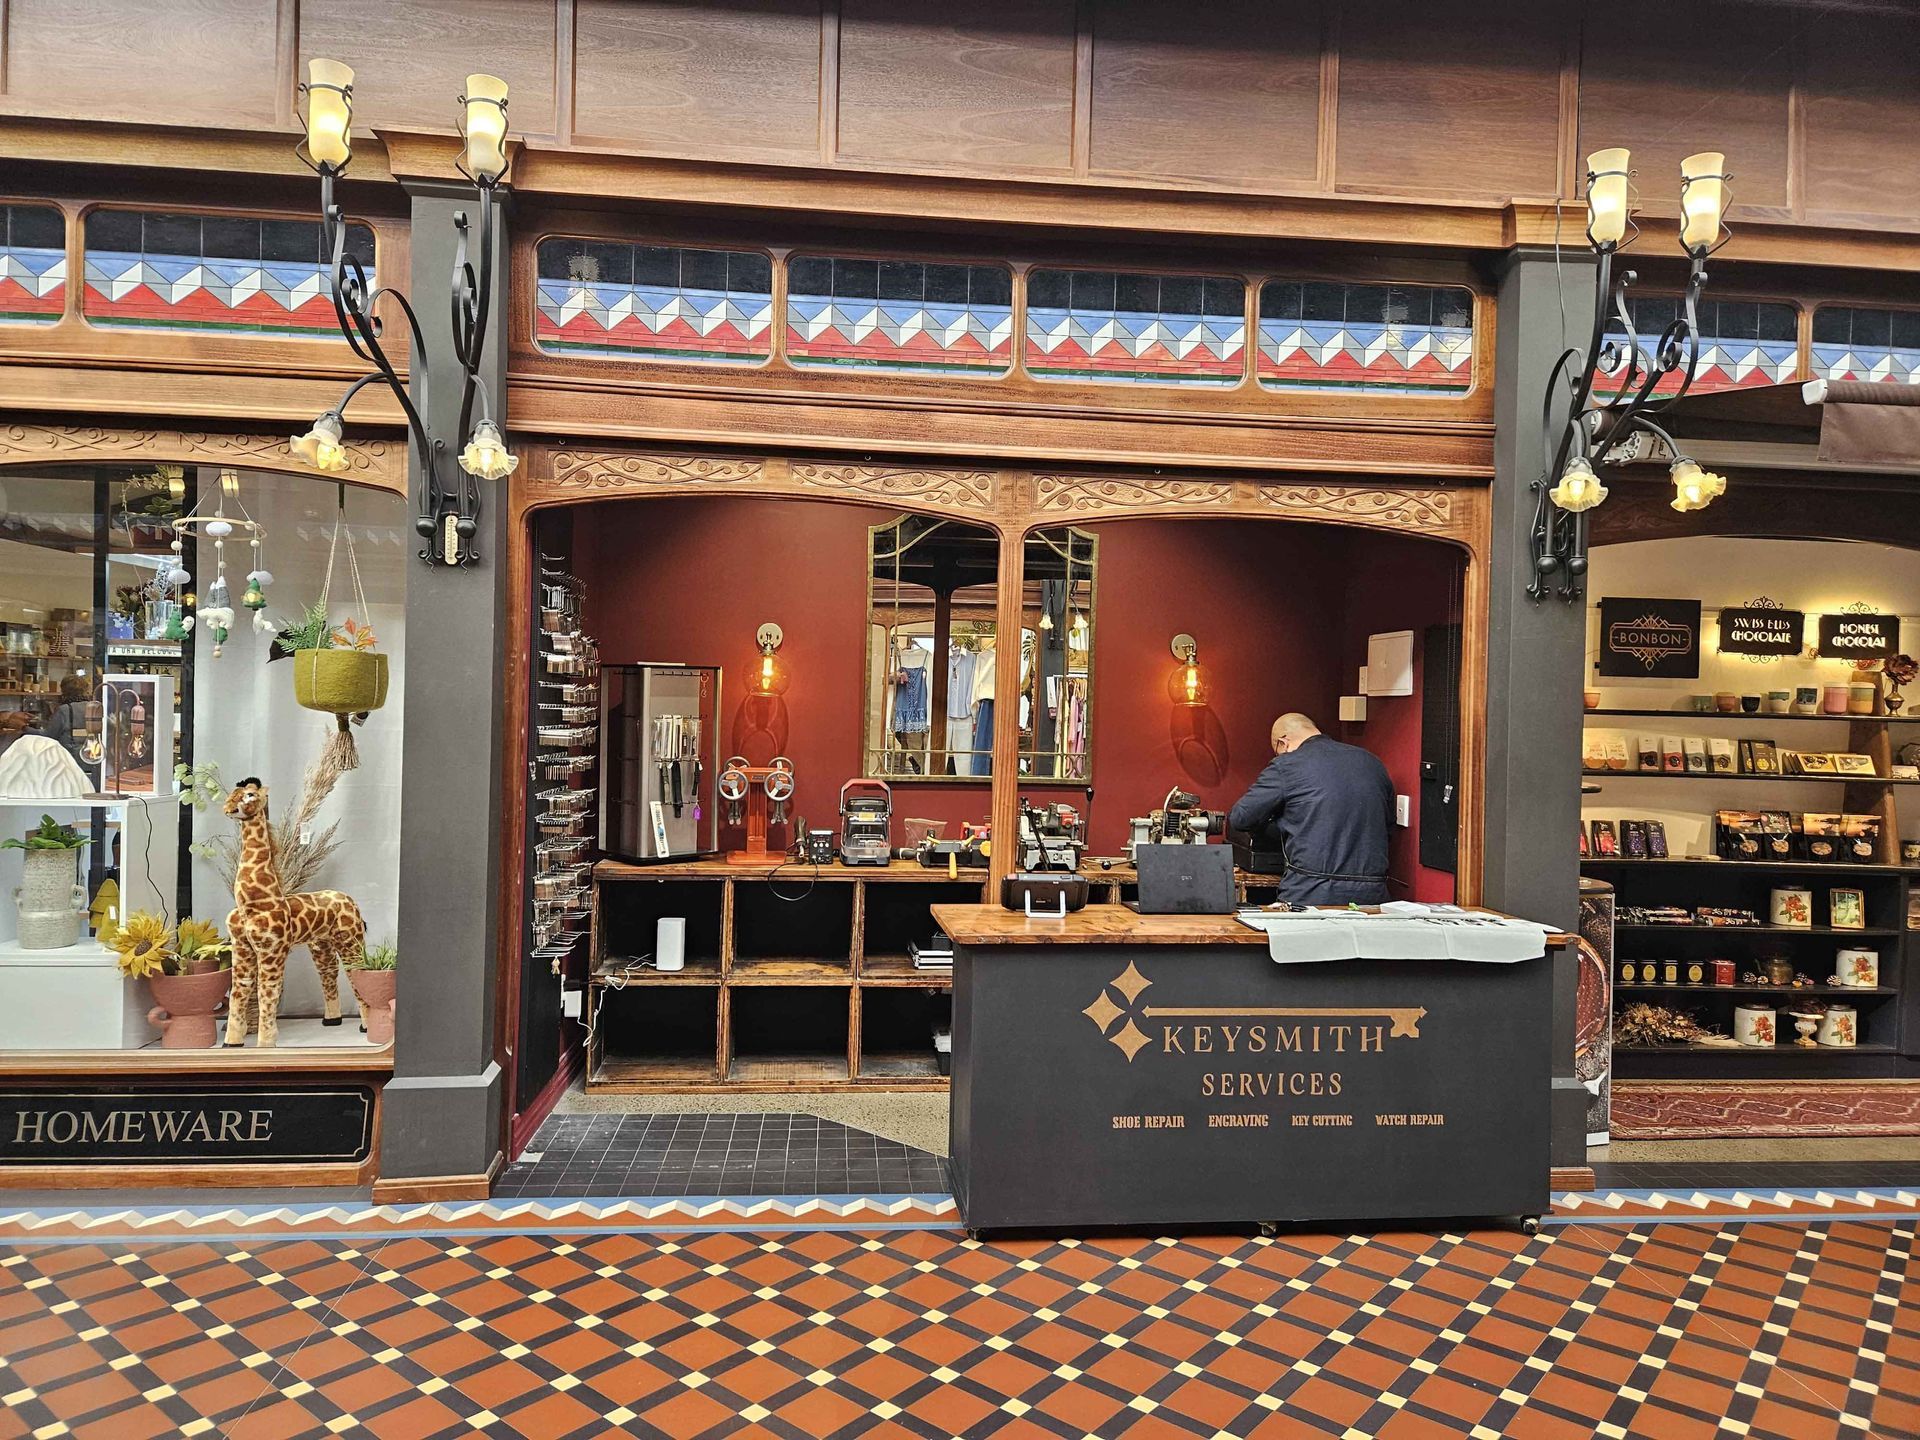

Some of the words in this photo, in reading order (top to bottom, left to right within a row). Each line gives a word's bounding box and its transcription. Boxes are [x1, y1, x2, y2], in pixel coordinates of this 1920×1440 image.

[1734, 618, 1764, 629] SWISS
[1767, 619, 1791, 630] BLISS
[1839, 623, 1880, 635] HONEST
[1620, 632, 1681, 645] BONBON
[1731, 630, 1792, 643] CHOCOLATE
[1163, 1025, 1384, 1054] KEYSMITH
[1202, 1072, 1342, 1097] SERVICES
[11, 1109, 274, 1144] HOMEWARE
[1112, 1115, 1141, 1129] SHOE
[1144, 1115, 1185, 1128] REPAIR
[1208, 1114, 1269, 1127] ENGRAVING
[1291, 1115, 1310, 1126] KEY
[1312, 1114, 1353, 1126] CUTTING
[1375, 1114, 1407, 1126] WATCH
[1410, 1114, 1444, 1126] REPAIR
